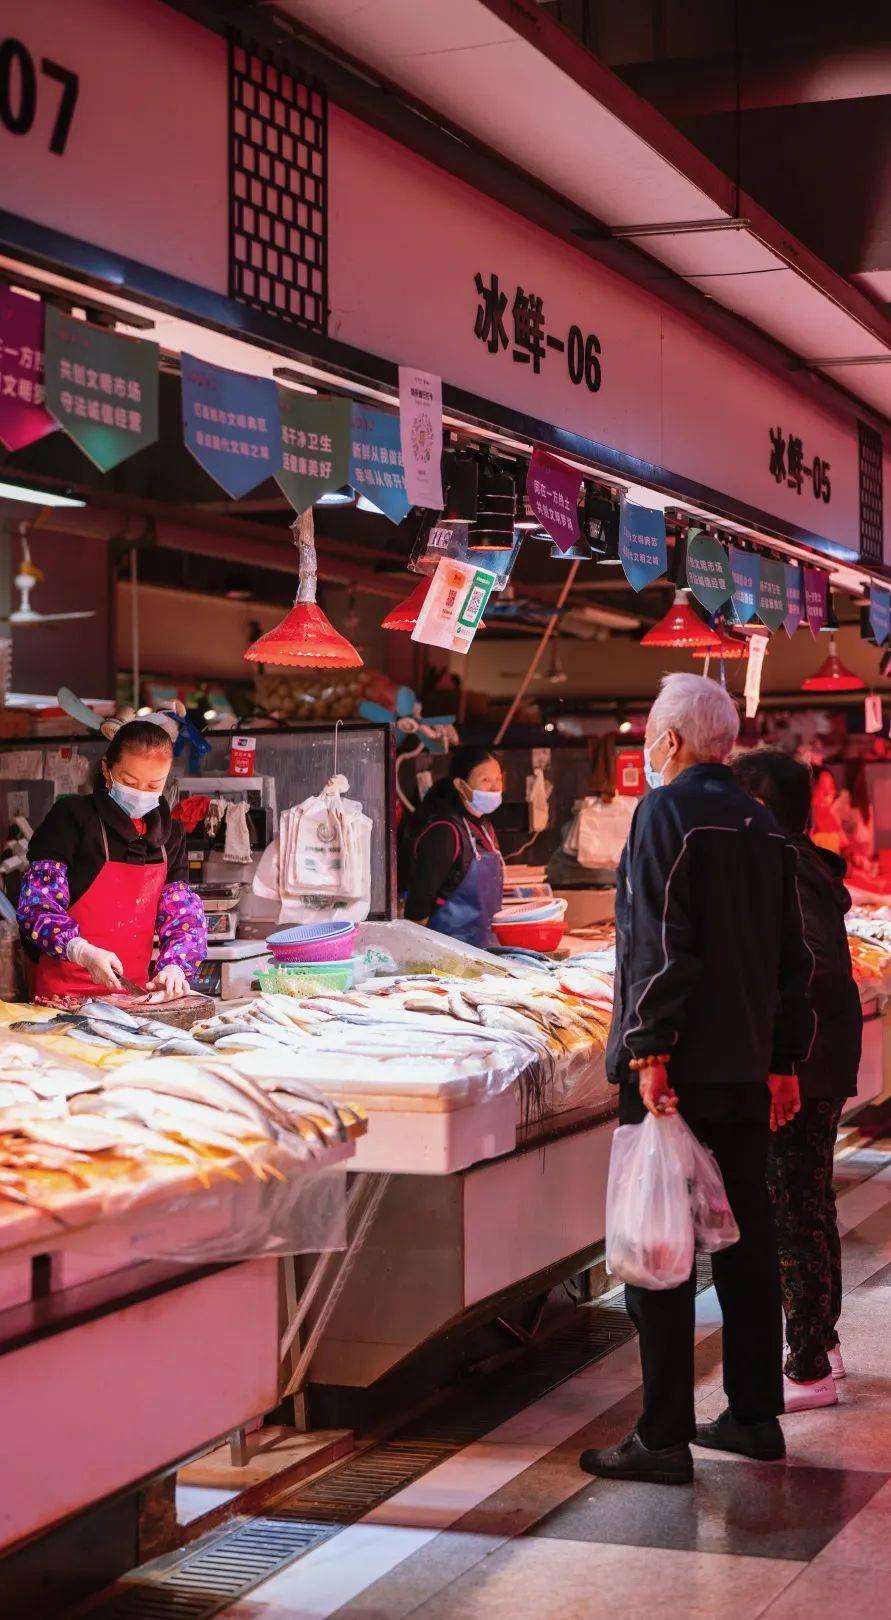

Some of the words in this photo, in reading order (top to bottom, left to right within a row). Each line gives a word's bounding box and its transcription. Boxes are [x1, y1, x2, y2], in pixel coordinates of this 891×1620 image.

[0, 37, 79, 157] 07
[474, 271, 601, 393] 冰鲜-06
[769, 426, 831, 503] 冰鲜-05
